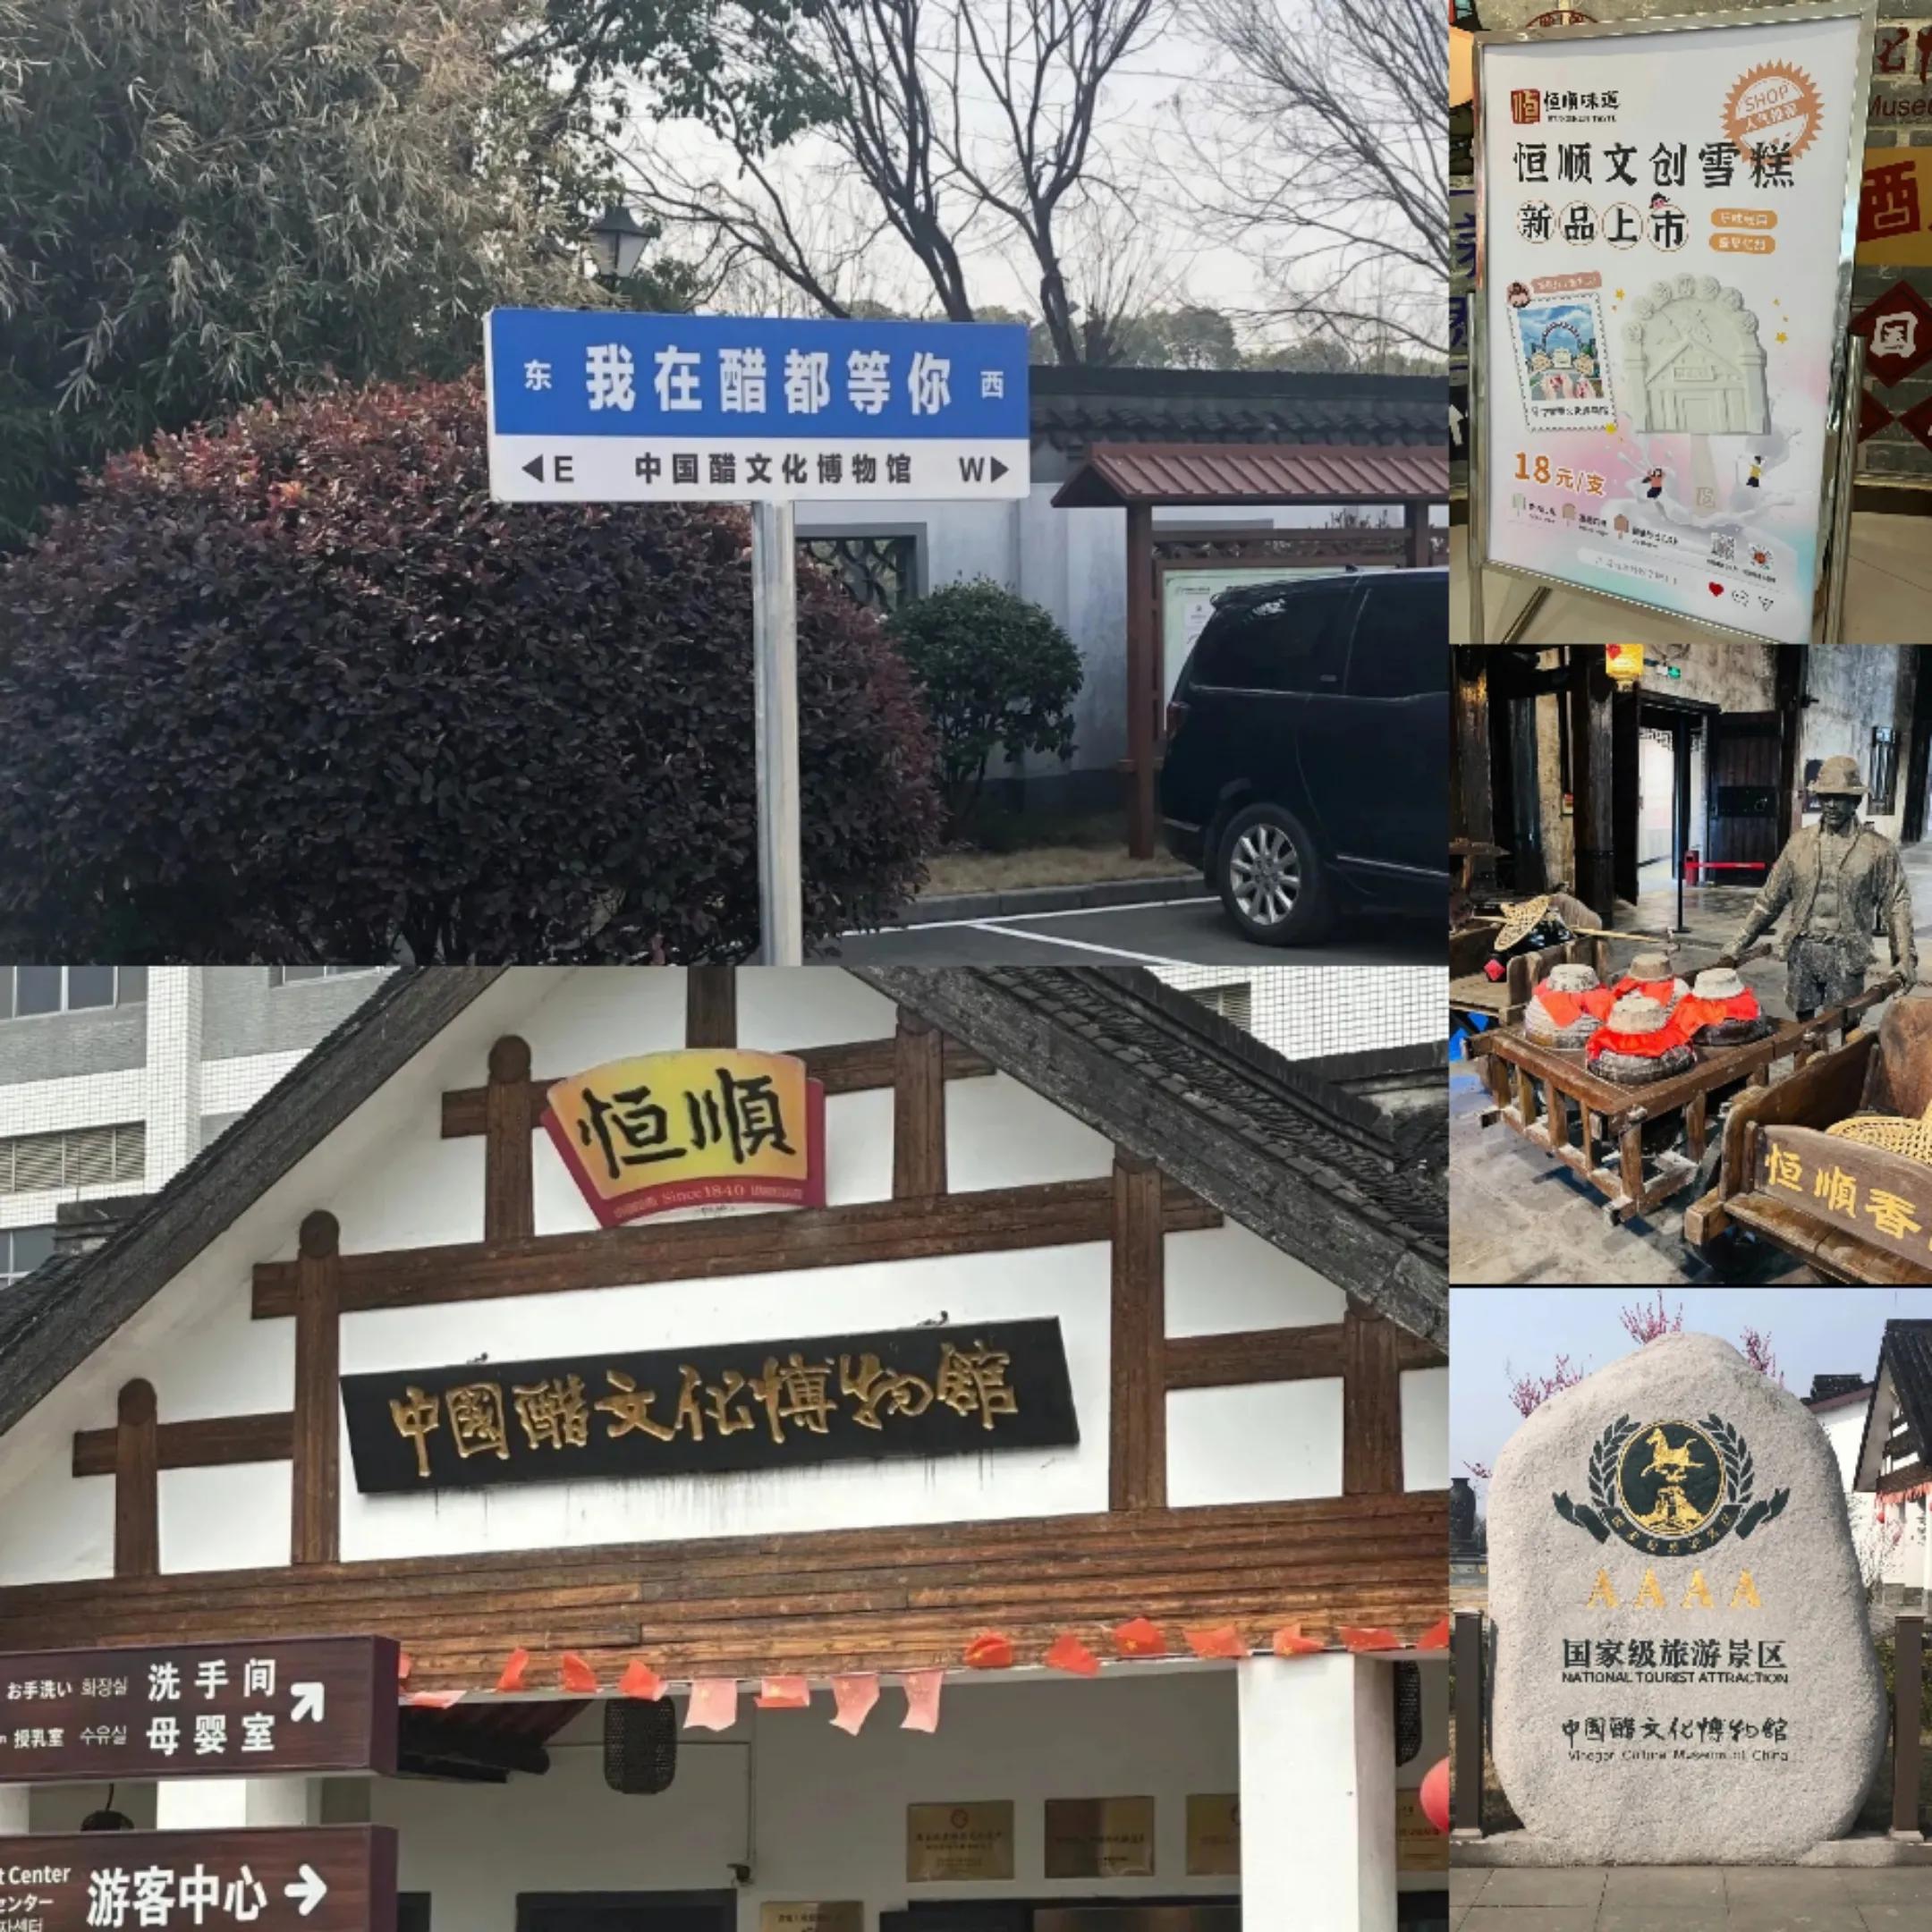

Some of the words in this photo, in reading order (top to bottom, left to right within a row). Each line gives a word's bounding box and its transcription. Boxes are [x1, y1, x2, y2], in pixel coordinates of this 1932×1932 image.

[1746, 84, 1788, 112] SHOP
[1513, 141, 1795, 189] 恒顺文创雪糕
[1519, 203, 1689, 250] 新品上市
[523, 360, 553, 391] 东
[585, 343, 953, 415] 我在醋都等你
[980, 369, 1005, 400] 西
[554, 455, 574, 482] E
[635, 452, 912, 485] 中国醋文化博物馆
[960, 456, 985, 482] W
[1563, 1639, 1788, 1669] 国家级旅游景区
[6, 1680, 73, 1700] お手洗い
[80, 1675, 129, 1698] 화장실
[147, 1657, 277, 1703] 洗手间
[1562, 1671, 1633, 1684] NATIONAL
[1637, 1671, 1695, 1684] TOURIST
[1699, 1671, 1789, 1684] ATTRACTION
[13, 1727, 65, 1750] 授乳室
[80, 1724, 127, 1746] 수유실
[145, 1711, 276, 1756] 母婴室
[8, 1865, 72, 1885] Center
[86, 1863, 267, 1928] 游客中心
